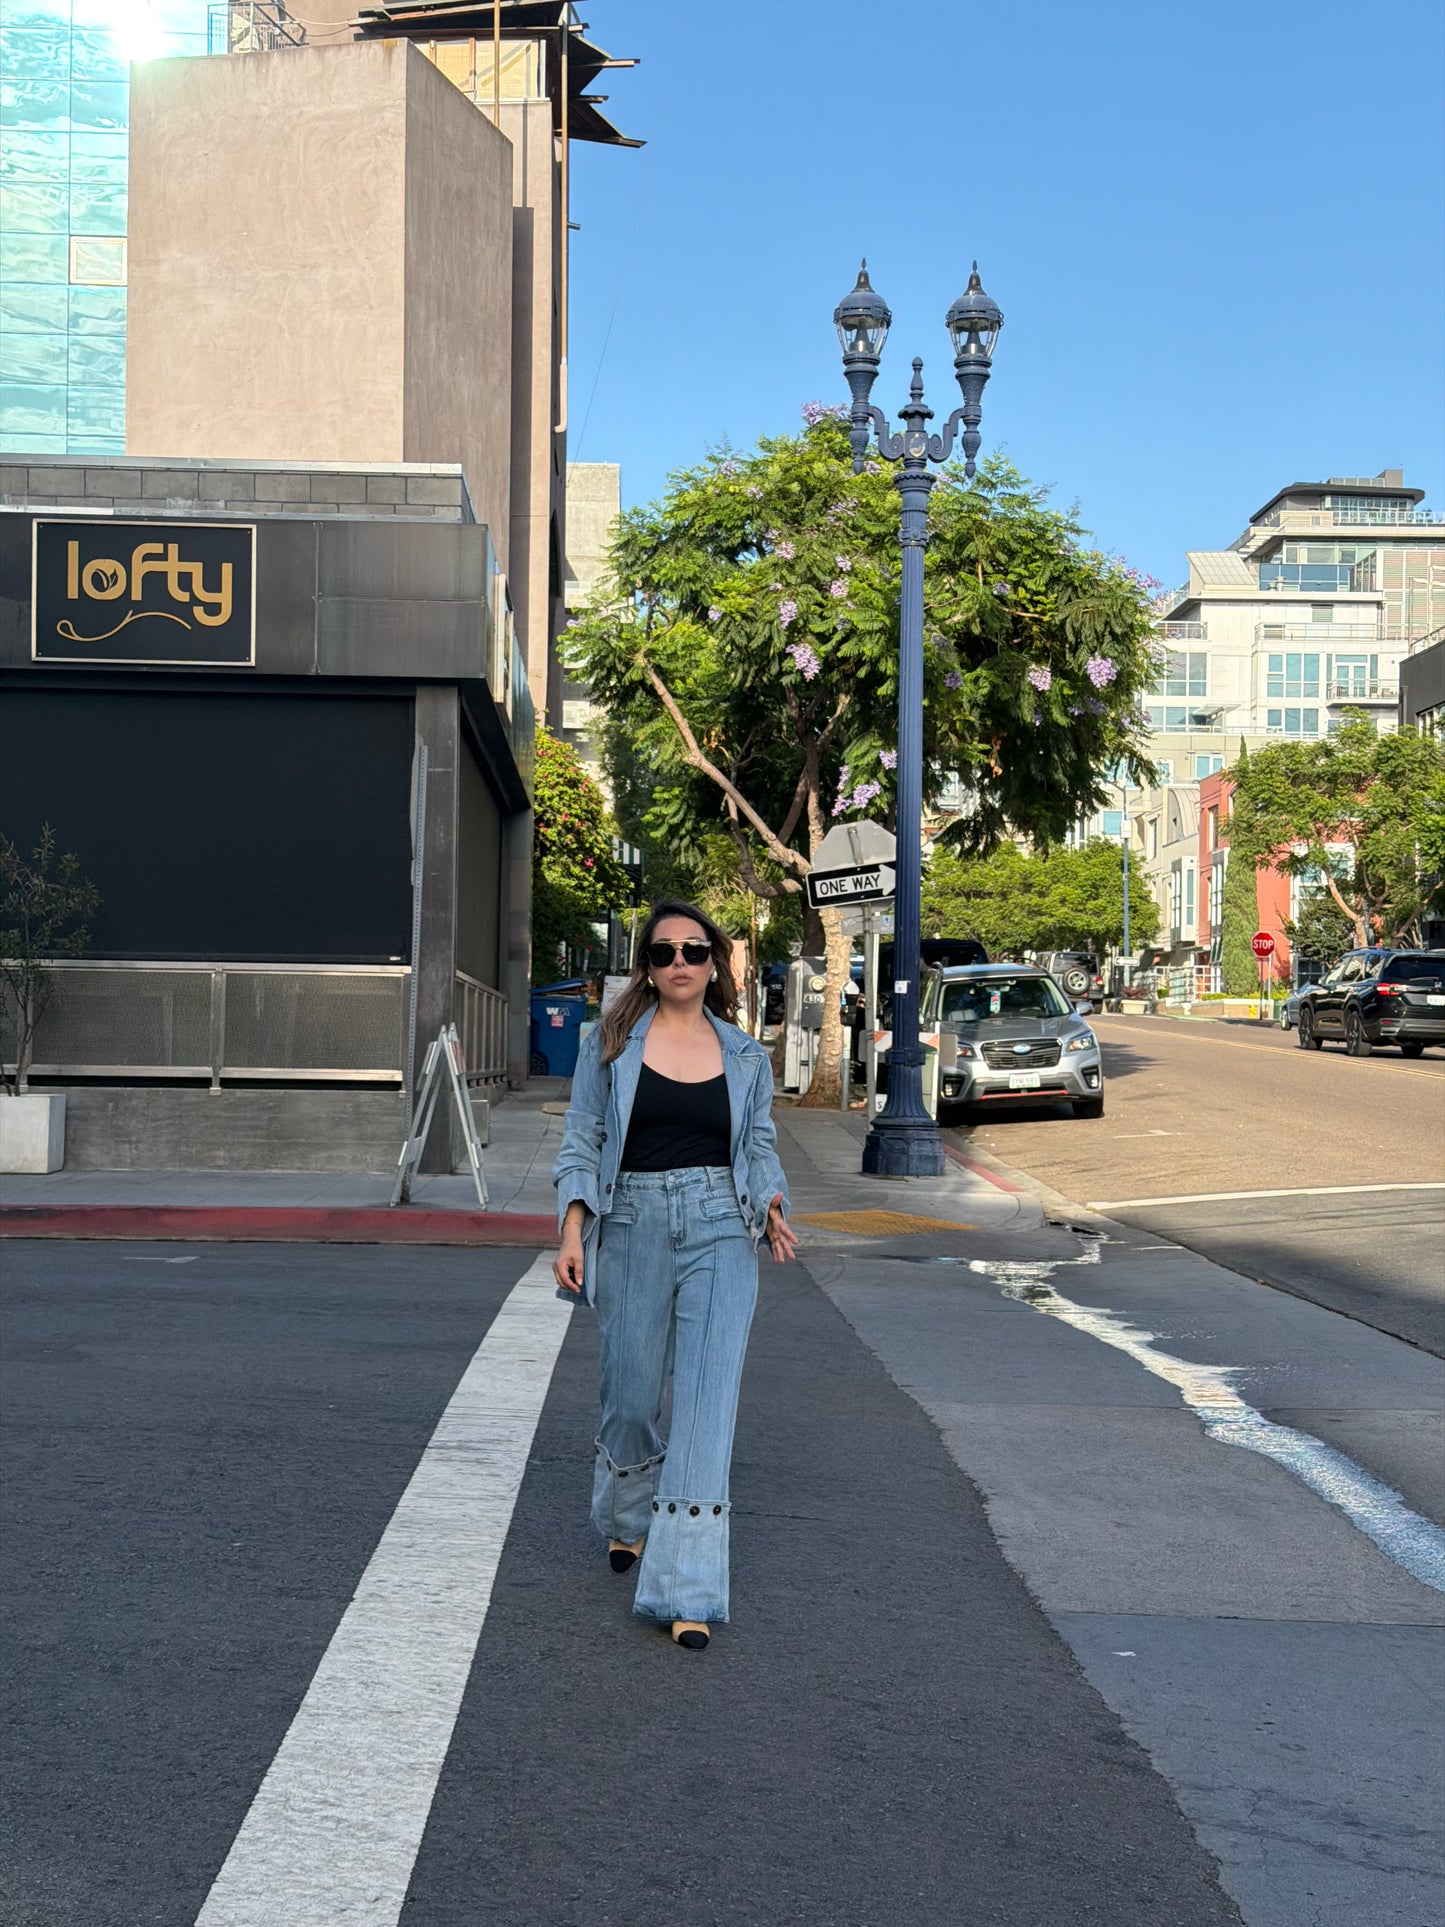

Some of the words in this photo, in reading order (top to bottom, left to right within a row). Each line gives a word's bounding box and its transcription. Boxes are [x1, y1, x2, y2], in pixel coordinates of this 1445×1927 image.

[67, 540, 233, 627] lofty
[820, 879, 848, 895] ONE
[852, 874, 880, 890] WAY
[1253, 939, 1274, 950] STOP
